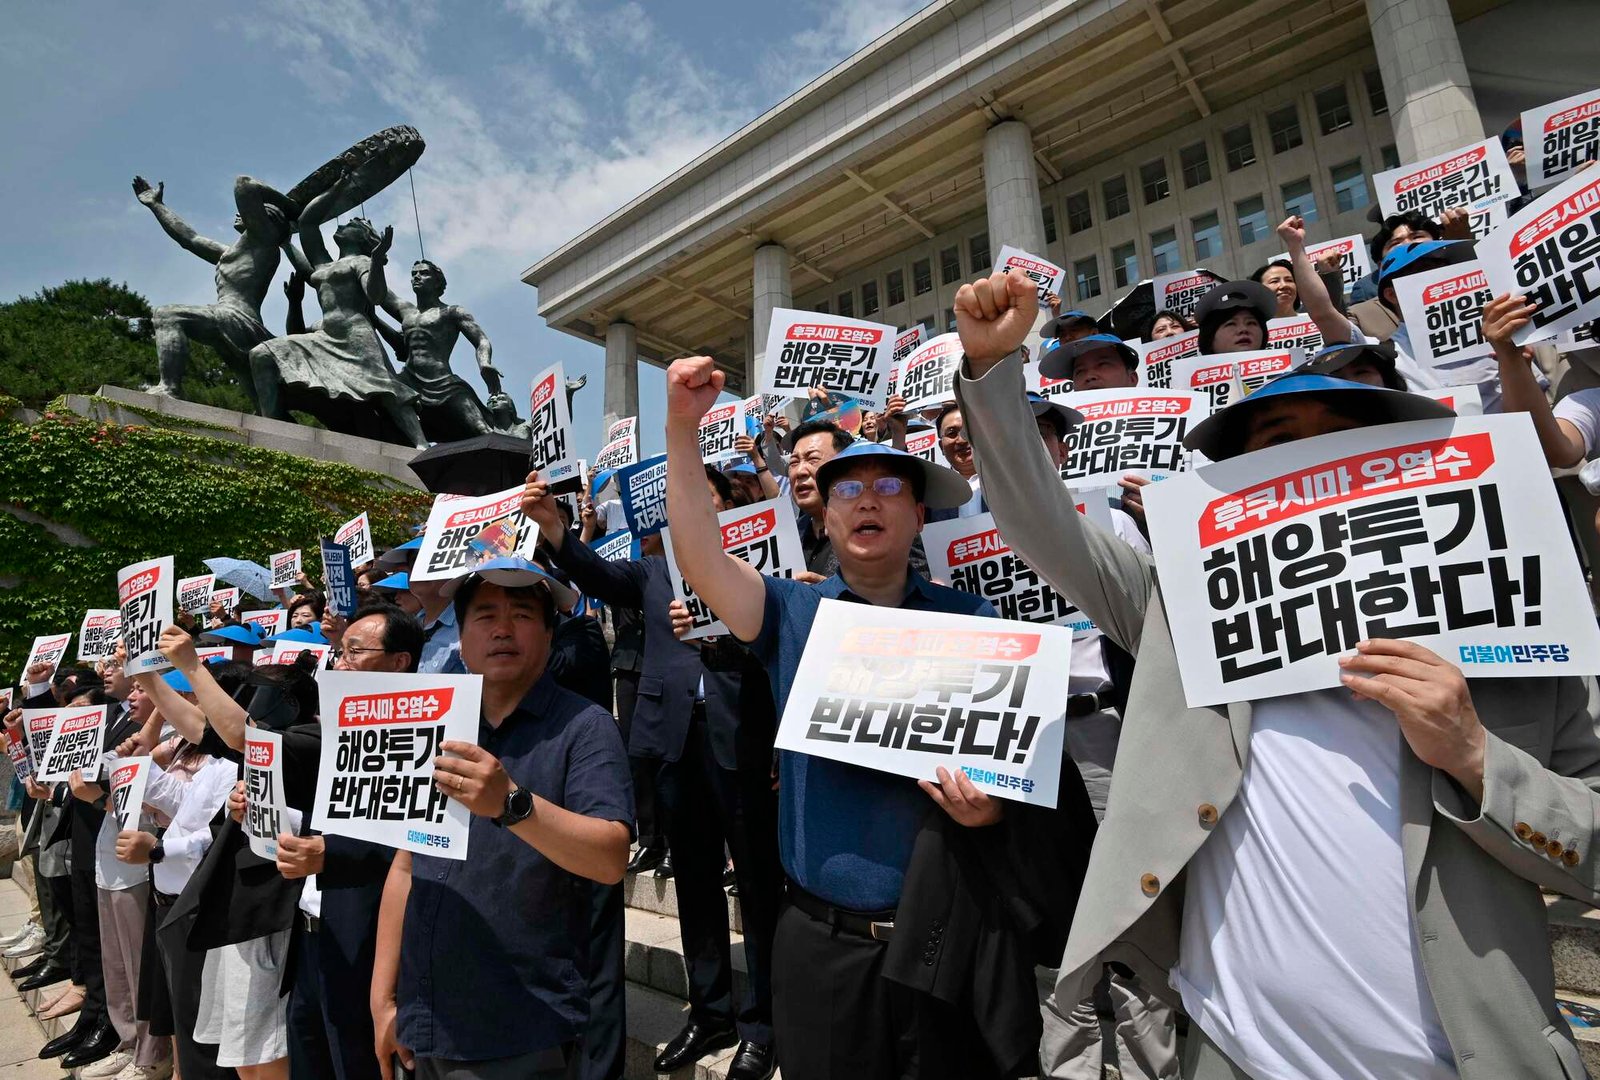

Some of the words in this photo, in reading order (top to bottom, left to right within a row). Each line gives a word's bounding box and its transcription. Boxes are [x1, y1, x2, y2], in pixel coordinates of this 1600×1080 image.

[1400, 166, 1443, 189] 후쿠시마
[1445, 151, 1480, 170] 오염수
[1395, 159, 1491, 212] 해양투기
[1411, 174, 1501, 219] 대한다!
[793, 325, 838, 341] 후쿠시마
[841, 328, 875, 343] 오염수
[780, 341, 878, 370] 해양투기
[1249, 358, 1284, 375] 오염수
[773, 366, 880, 395] 반대한다!
[1138, 399, 1181, 413] 오염수
[1064, 417, 1187, 451] 해양투기
[533, 428, 566, 471] 한다!
[1213, 463, 1355, 533] 후쿠시마
[1361, 445, 1471, 492] 오염수
[452, 507, 497, 525] 후쿠시마
[726, 517, 768, 545] 오염수
[1203, 482, 1508, 611] 해양투기
[130, 573, 153, 593] 오염수
[1212, 554, 1542, 684] 반대한다!
[1458, 643, 1570, 665] 더불어민주당
[826, 656, 1031, 708] 해양투기
[344, 698, 394, 721] 후쿠시마
[396, 694, 440, 719] 오염수
[53, 727, 100, 754] 해양투기
[805, 696, 1041, 764] 반대한다!
[46, 747, 99, 776] 반대한다!
[251, 745, 269, 763] 오염수
[336, 725, 446, 773] 해양투기
[960, 765, 1035, 793] 더불어민주당
[327, 774, 448, 824] 반대한다!
[407, 829, 451, 849] 더불어민주당
